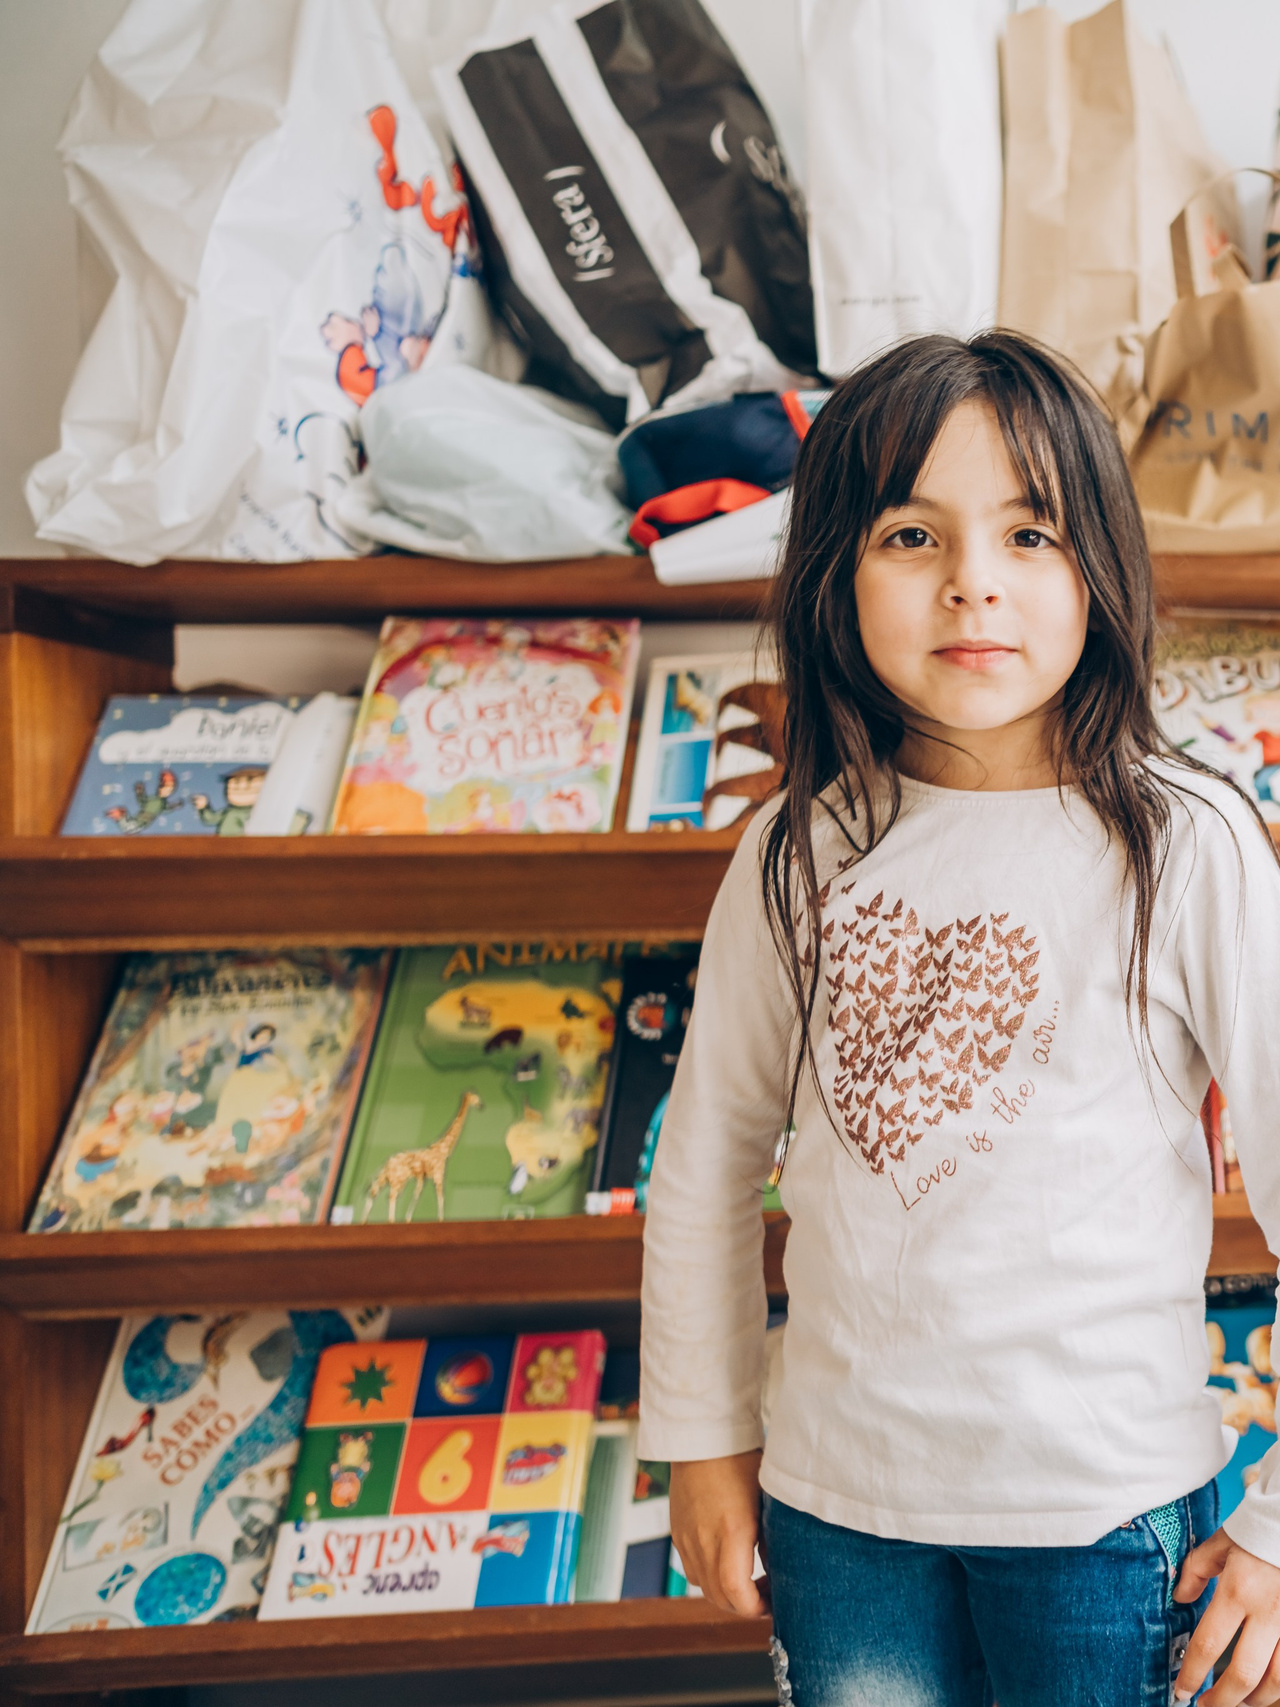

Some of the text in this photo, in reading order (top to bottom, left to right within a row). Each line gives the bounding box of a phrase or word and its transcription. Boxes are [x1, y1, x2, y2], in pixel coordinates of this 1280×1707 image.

[890, 1156, 957, 1211] Love
[966, 1129, 993, 1152] is
[990, 1078, 1036, 1124] the
[142, 1394, 219, 1469] SABES
[418, 1430, 473, 1506] 6
